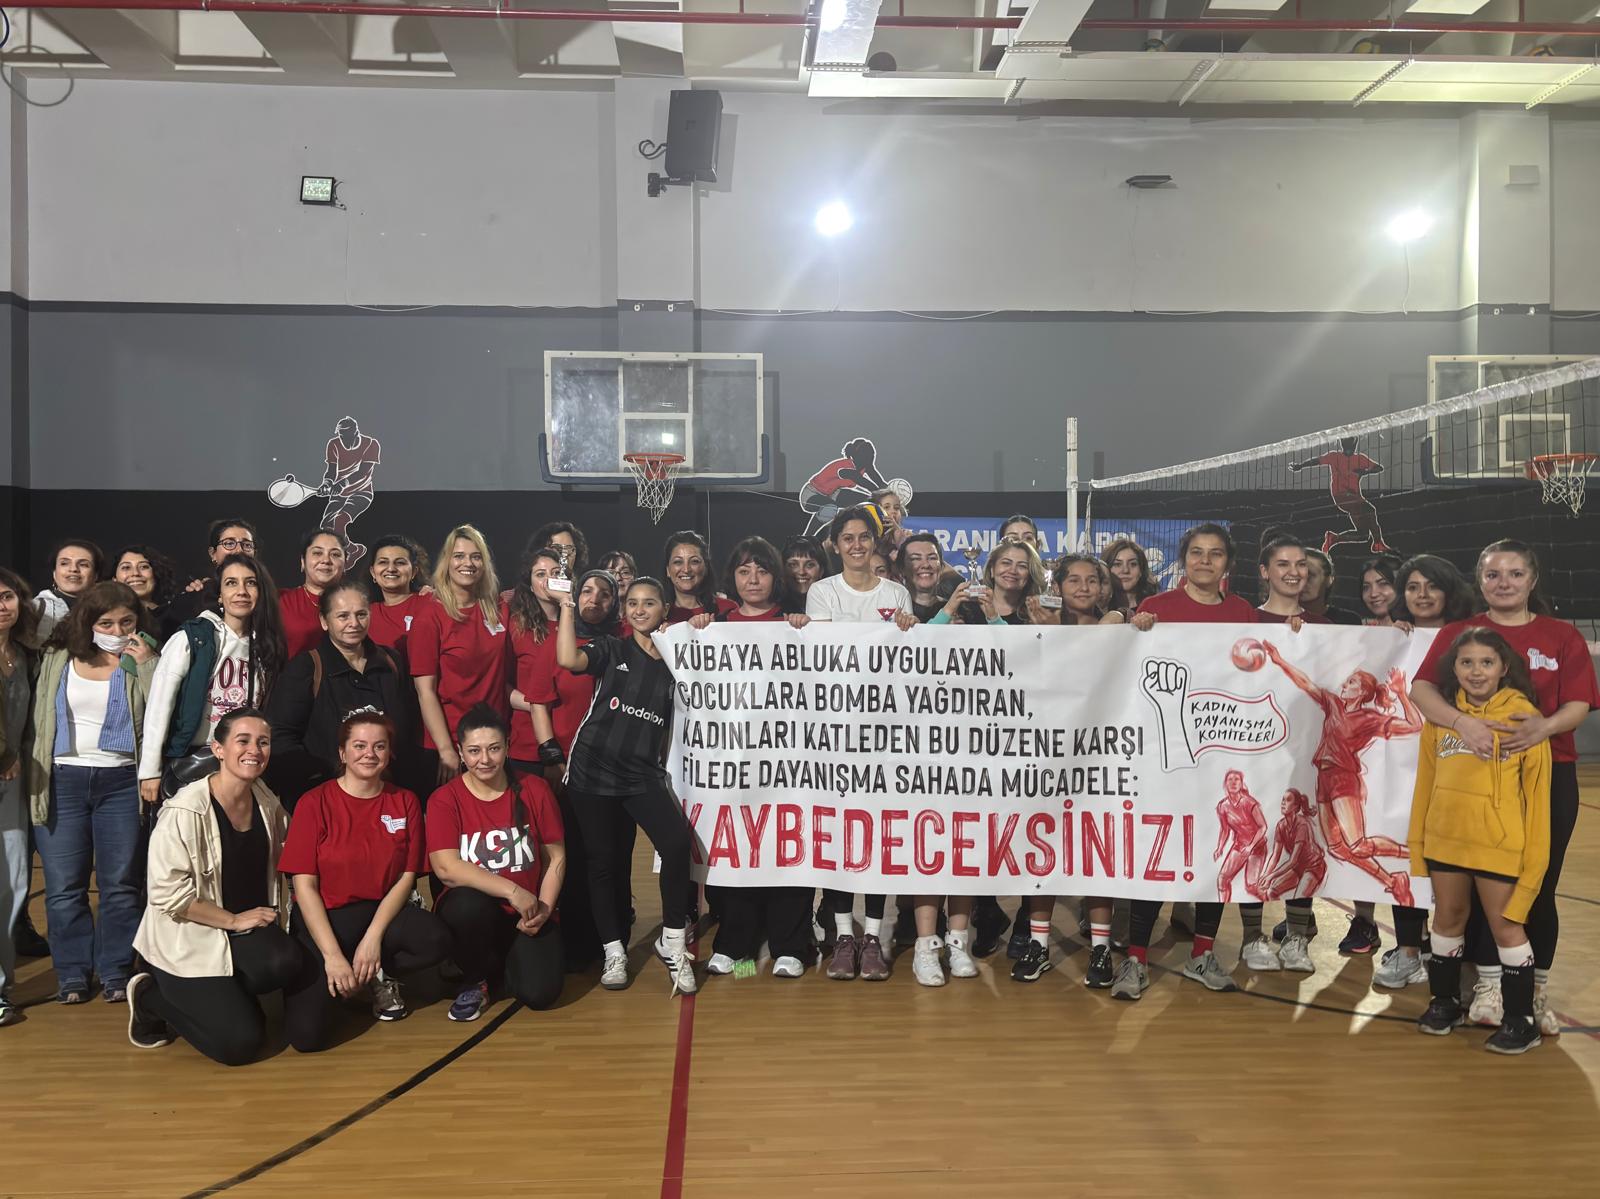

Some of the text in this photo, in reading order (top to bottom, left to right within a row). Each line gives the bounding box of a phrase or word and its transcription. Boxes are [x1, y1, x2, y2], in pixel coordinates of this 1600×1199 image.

[674, 640, 1014, 681] KÜBA'YA ABLUKA UYGULAYAN,
[677, 680, 1034, 721] ÇOCUKLARA BOMBA YAĞDIRAN,
[1191, 701, 1238, 715] KADIN
[682, 717, 1144, 761] KADINLARI KATLEDEN BU DÜZENE KARŞI
[1194, 715, 1273, 730] DAYANIŞMA
[682, 752, 1139, 798] FİLEDE DAYANIŞMA SAHADA MÜCADELE:
[682, 799, 1195, 882] KAYBEDECEKSİNİZ!
